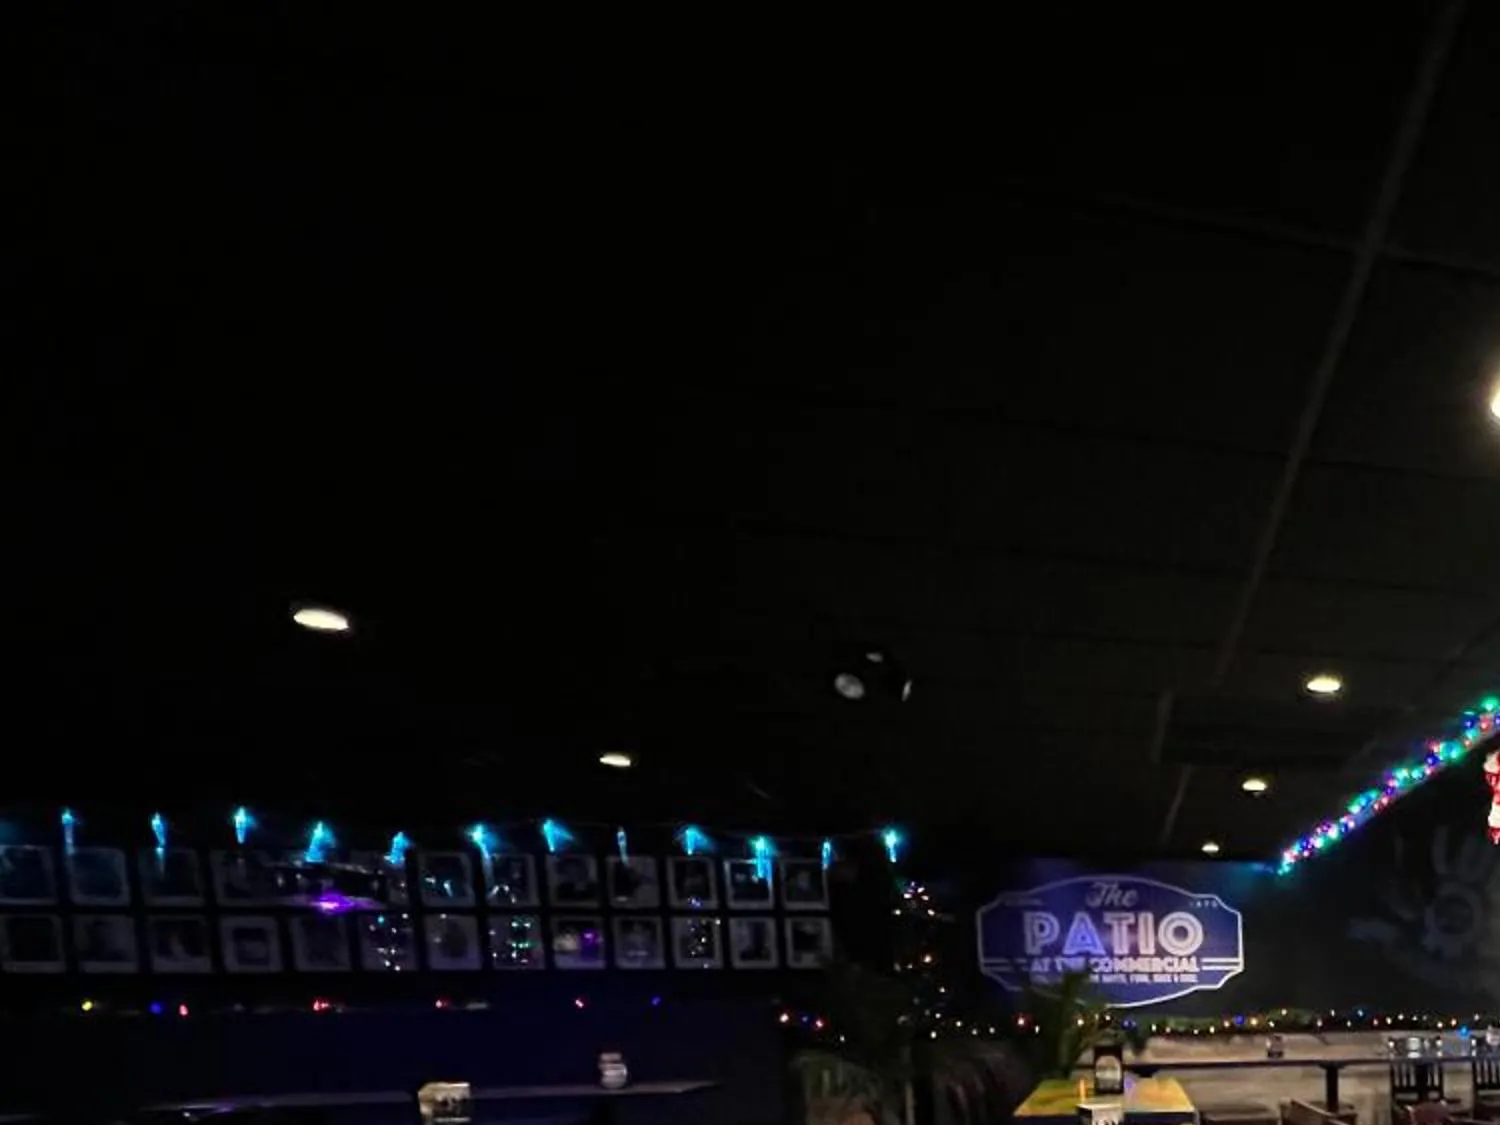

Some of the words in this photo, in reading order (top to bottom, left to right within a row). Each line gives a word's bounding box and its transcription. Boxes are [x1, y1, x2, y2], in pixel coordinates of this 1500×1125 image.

[1086, 881, 1138, 908] The
[1023, 911, 1204, 957] PATIO
[1089, 957, 1200, 973] COMMERCIAL
